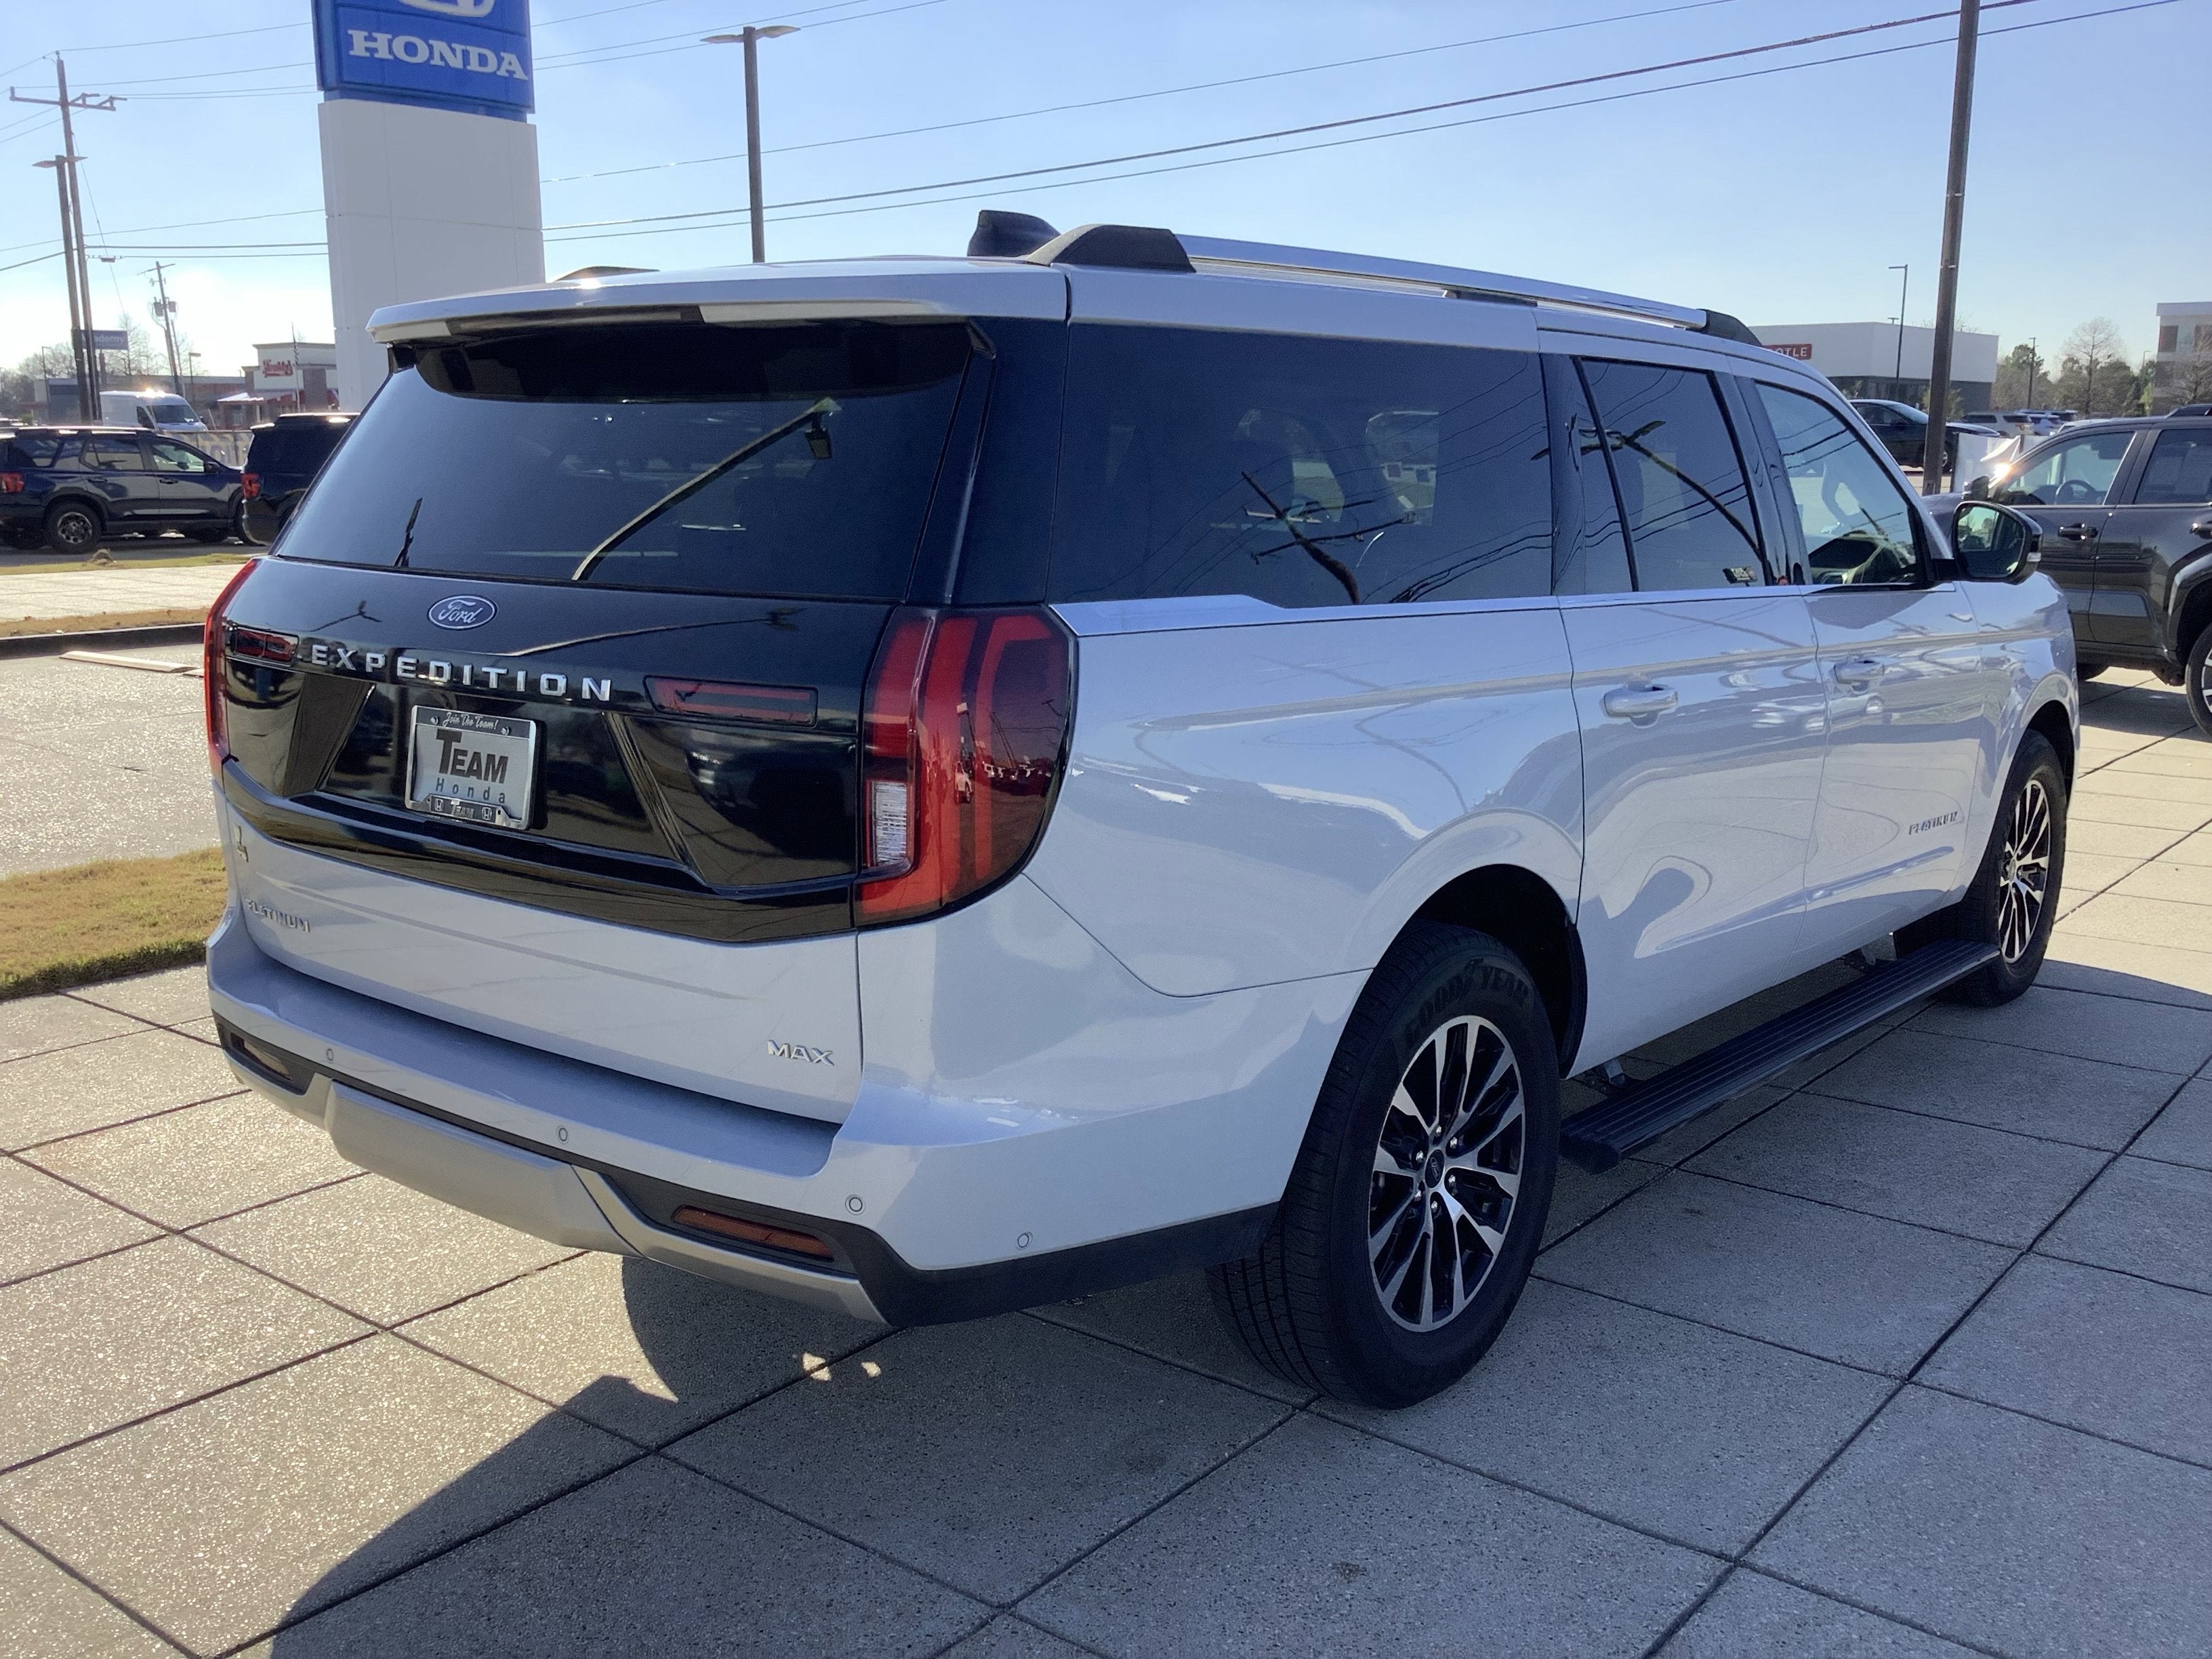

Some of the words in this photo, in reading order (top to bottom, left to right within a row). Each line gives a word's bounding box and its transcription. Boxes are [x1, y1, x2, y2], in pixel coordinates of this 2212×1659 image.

[348, 30, 528, 81] HONDA
[438, 599, 483, 623] Ford
[312, 644, 611, 701] EXPEDITION
[443, 712, 460, 727] Join
[461, 714, 474, 726] The
[475, 716, 499, 730] Team!
[436, 729, 508, 784] TEAM
[436, 778, 506, 804] Honda
[450, 800, 474, 819] TEAM
[767, 1040, 835, 1066] MAX
